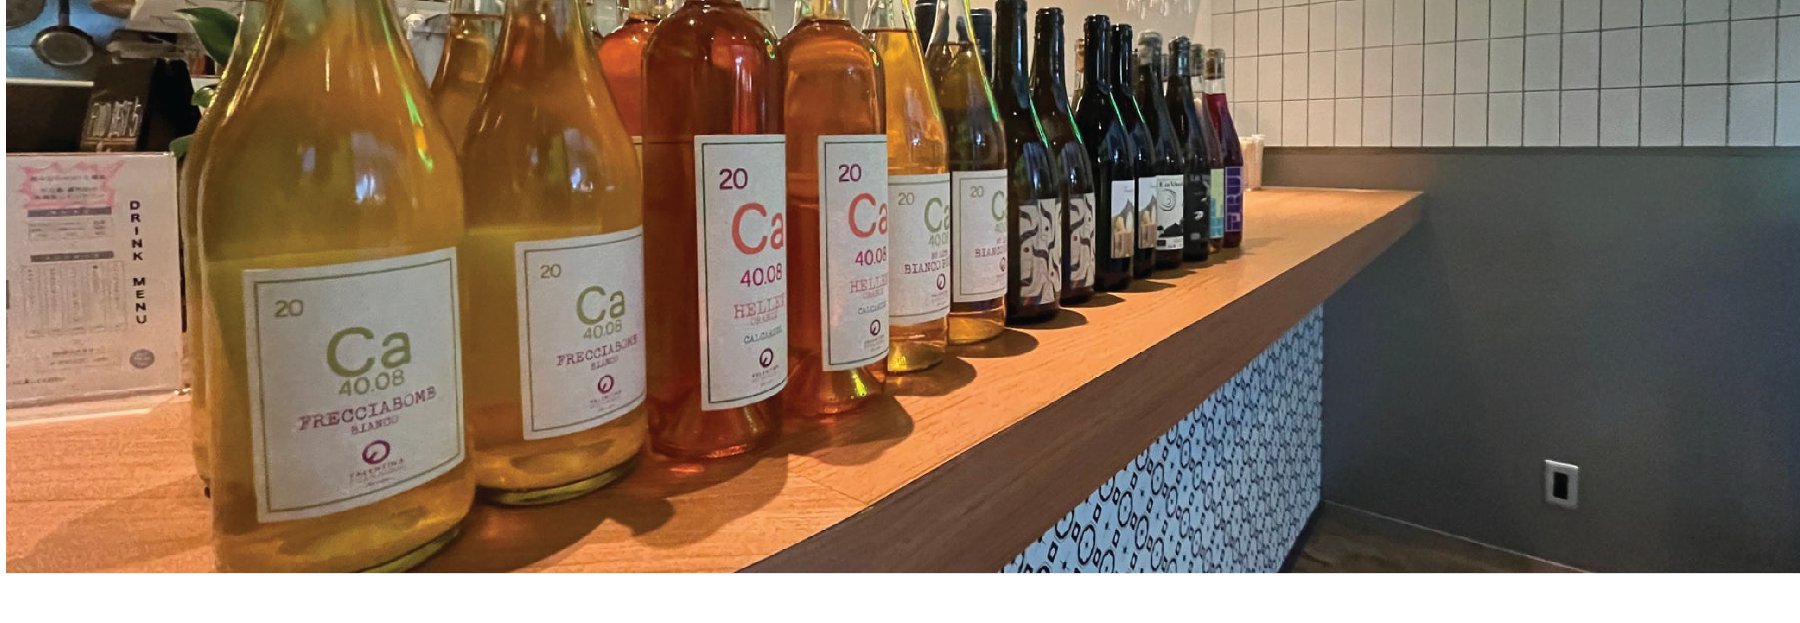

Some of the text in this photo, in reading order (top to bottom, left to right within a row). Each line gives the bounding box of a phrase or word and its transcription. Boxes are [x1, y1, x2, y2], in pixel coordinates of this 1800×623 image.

[719, 168, 748, 190] 20
[838, 164, 862, 182] 20
[898, 192, 914, 206] 20
[970, 185, 984, 198] 20
[848, 192, 887, 239] Ca
[731, 203, 784, 255] Ca
[129, 200, 147, 324] DRINK MENU
[855, 246, 886, 266] 40.08
[540, 264, 561, 279] 20
[740, 263, 783, 287] 40.08
[274, 299, 304, 318] 20
[576, 285, 625, 325] Ca
[583, 319, 622, 339] 40.08
[326, 326, 412, 378] Ca
[338, 369, 405, 396] 40.08
[298, 386, 437, 431] FRECCIABOMB
